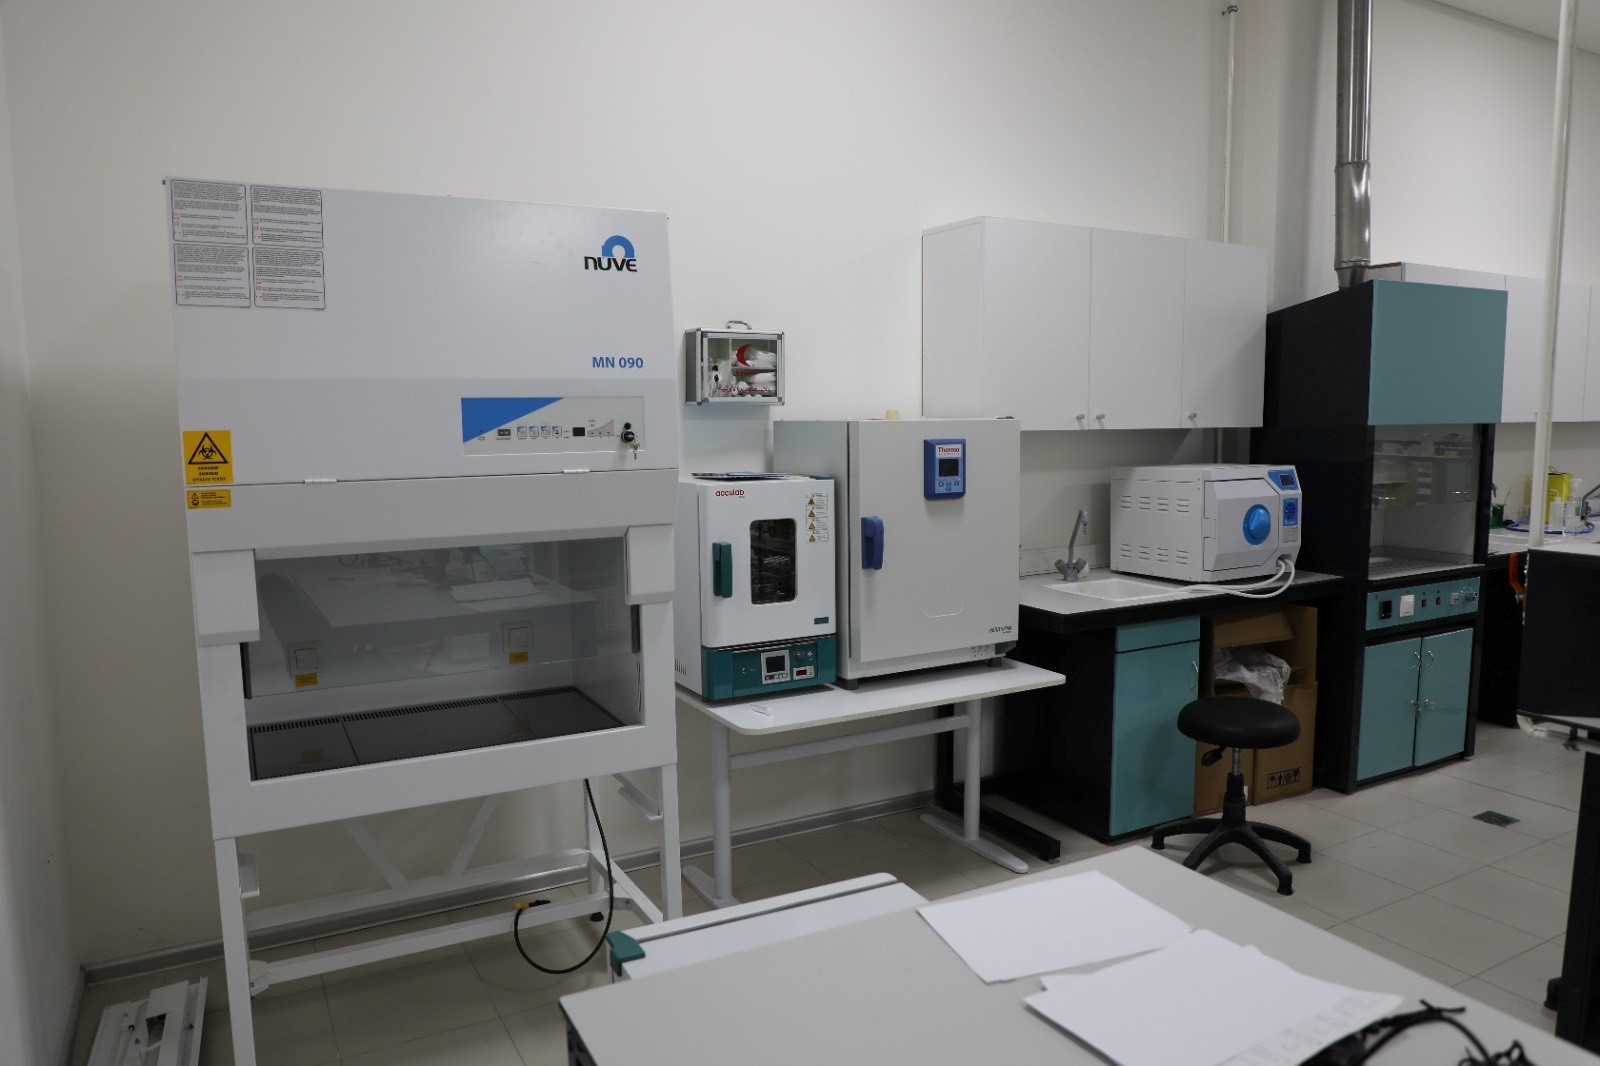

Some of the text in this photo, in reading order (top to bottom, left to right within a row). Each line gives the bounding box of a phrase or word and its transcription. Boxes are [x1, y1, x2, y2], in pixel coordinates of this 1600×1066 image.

[592, 356, 644, 369] MN 090
[715, 489, 745, 497] acculab
